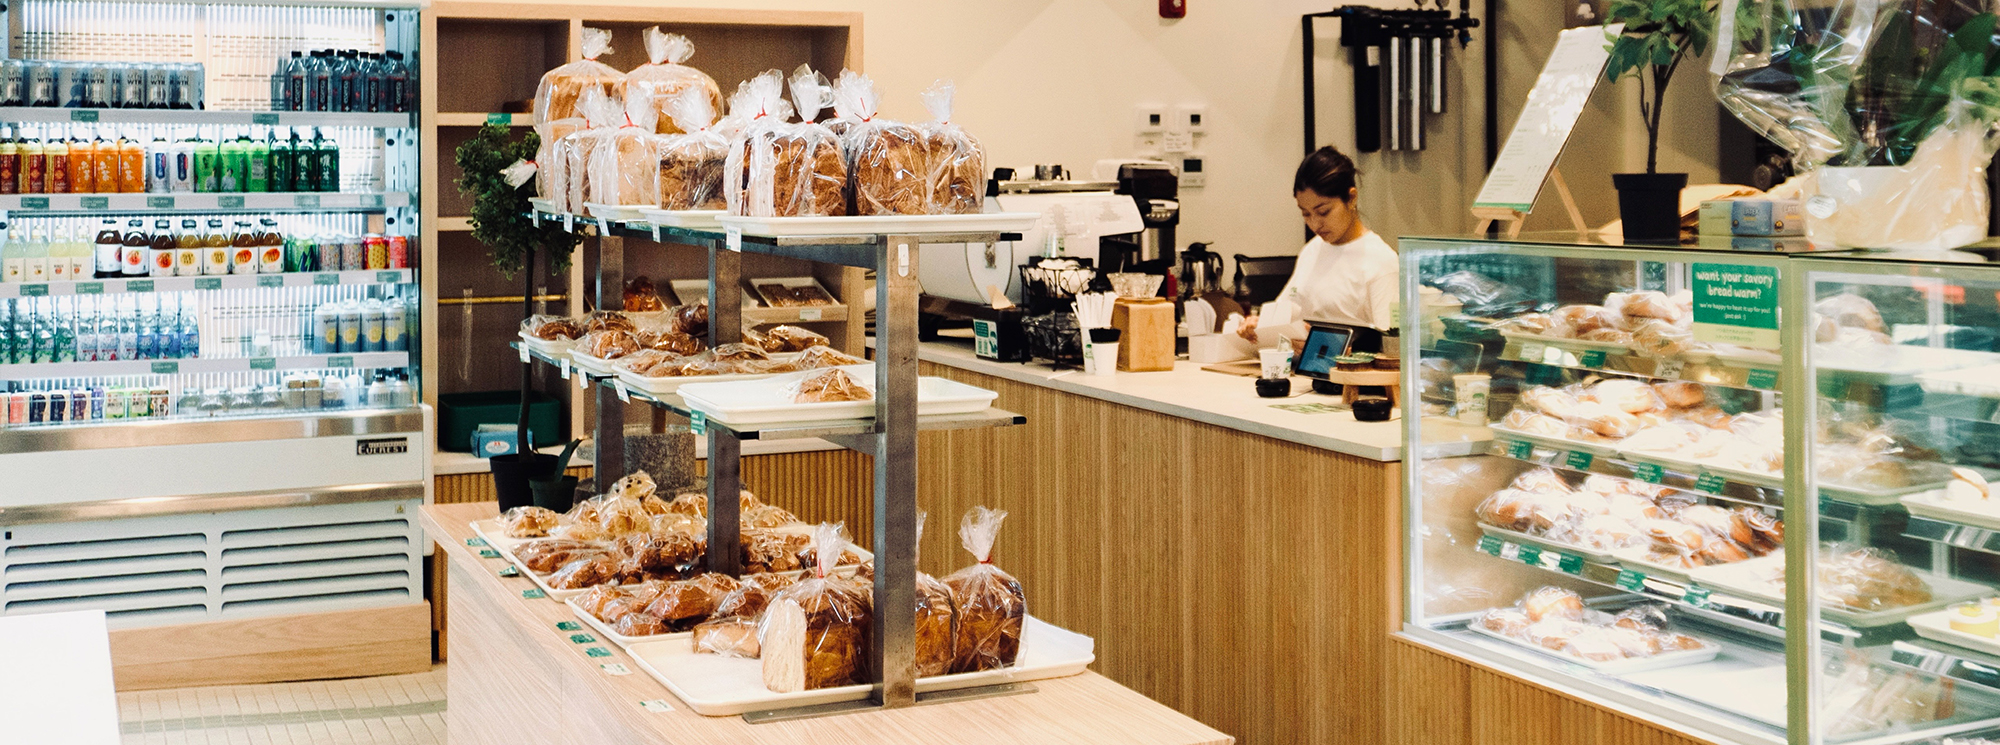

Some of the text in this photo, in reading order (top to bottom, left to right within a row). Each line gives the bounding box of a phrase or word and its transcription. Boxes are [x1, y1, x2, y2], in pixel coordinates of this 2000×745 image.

[1696, 271, 1774, 289] want your savory
[1707, 283, 1762, 299] bread warm?
[1712, 303, 1726, 311] happy
